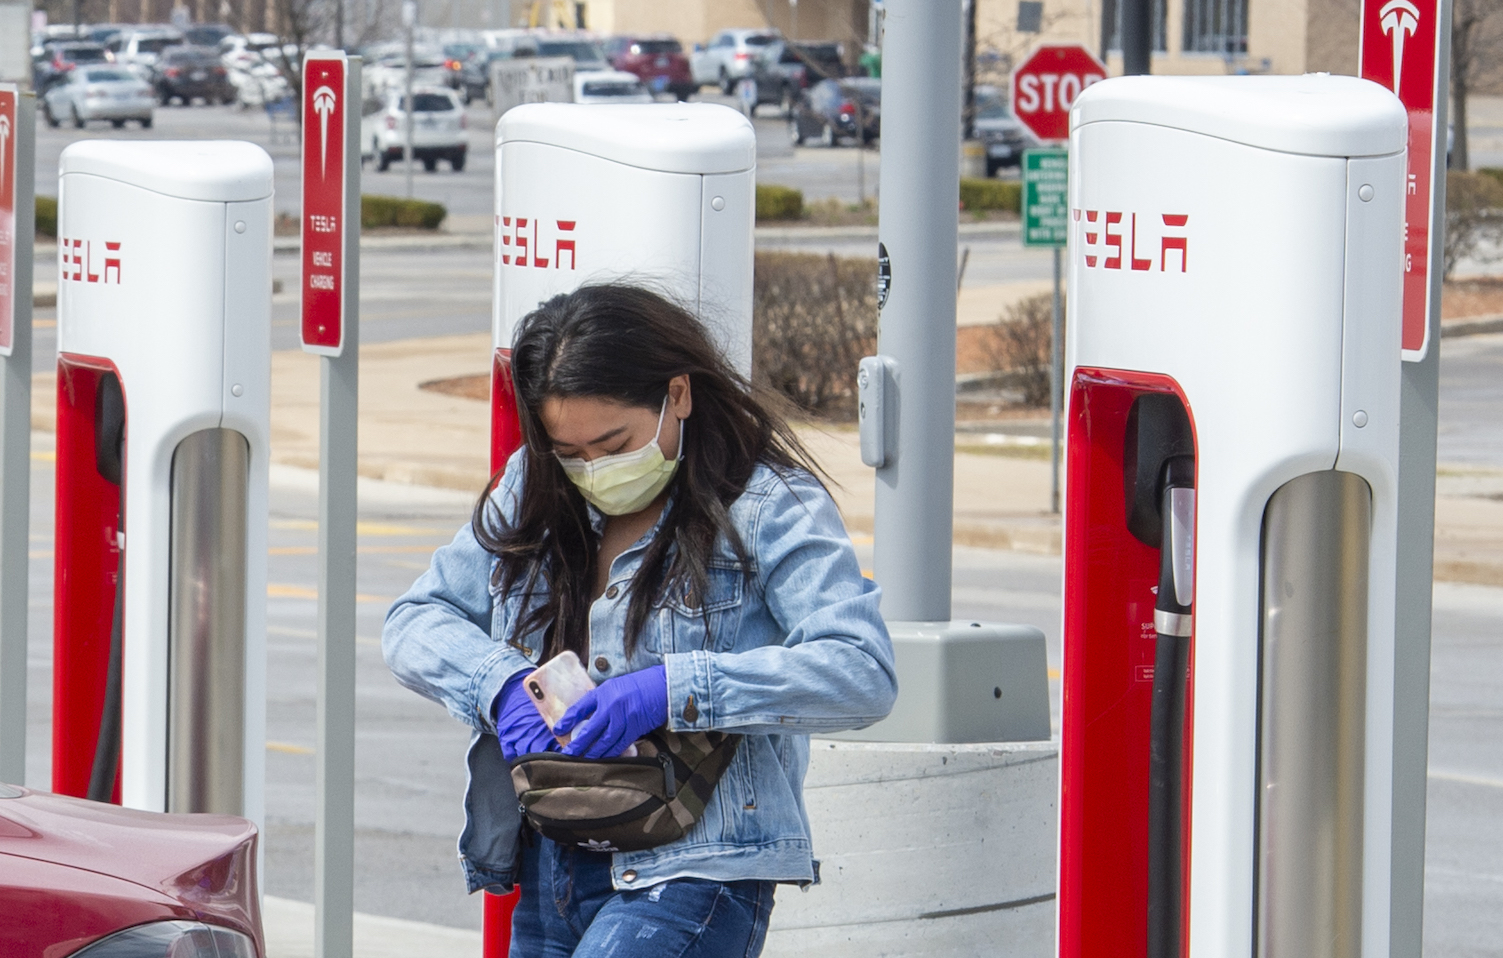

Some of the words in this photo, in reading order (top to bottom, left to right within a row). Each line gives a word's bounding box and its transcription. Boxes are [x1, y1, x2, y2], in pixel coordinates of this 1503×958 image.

[1019, 73, 1107, 113] STO
[310, 215, 336, 232] TESLA
[496, 215, 576, 270] ESLA
[62, 238, 121, 284] ESLA
